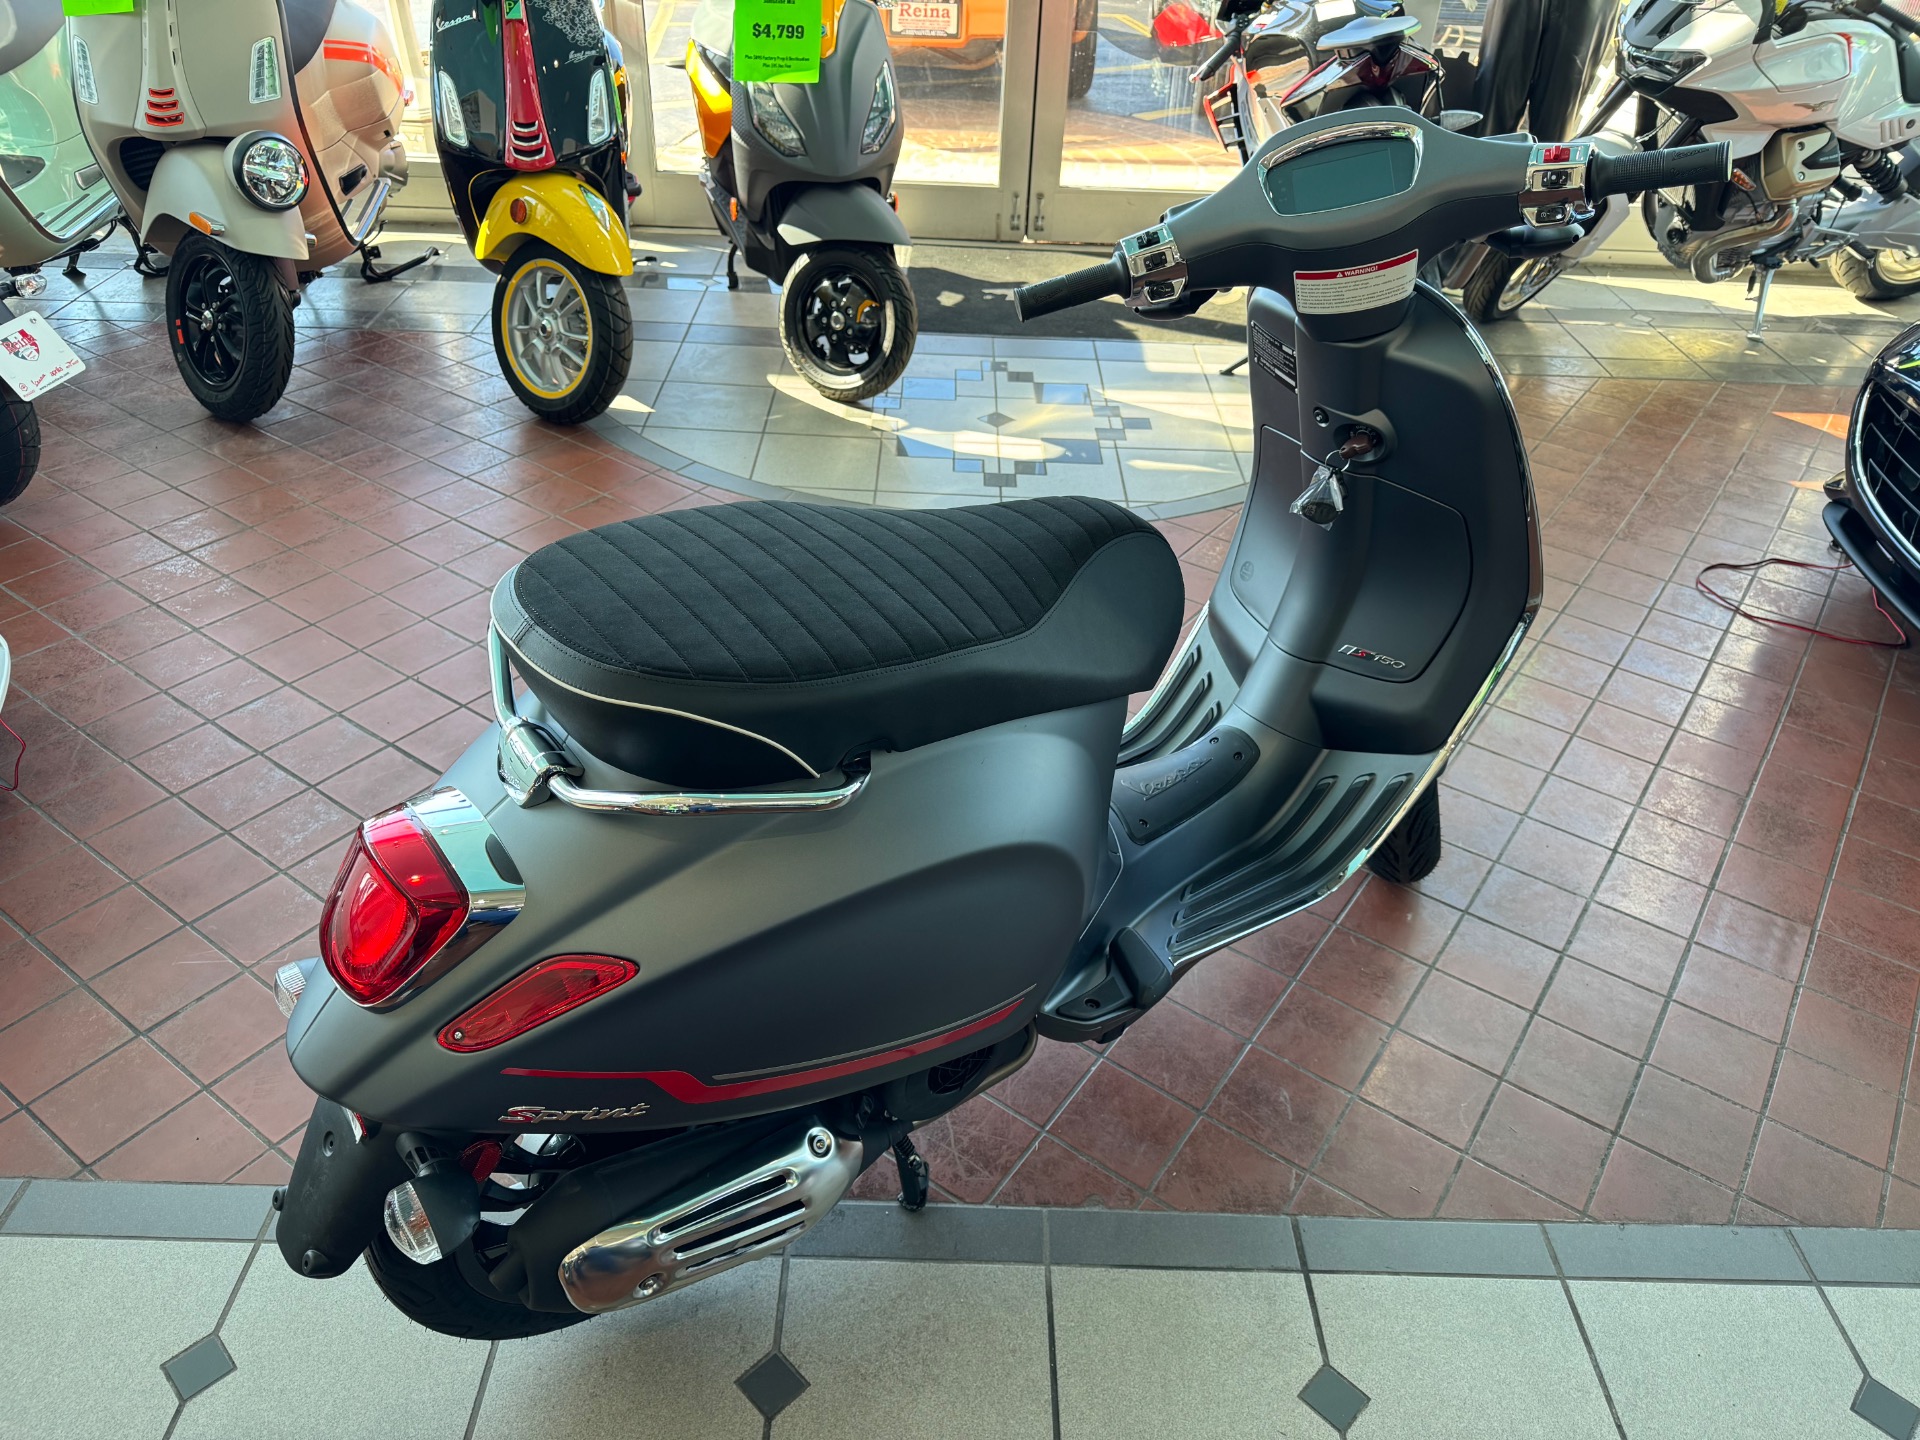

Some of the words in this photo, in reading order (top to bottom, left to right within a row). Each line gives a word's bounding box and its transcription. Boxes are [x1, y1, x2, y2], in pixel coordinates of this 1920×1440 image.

[899, 3, 951, 19] Reina
[436, 14, 475, 33] Vespa
[752, 22, 805, 40] $4,799
[1344, 265, 1379, 277] WARNING!
[1120, 757, 1214, 801] Vespa
[498, 1102, 651, 1124] Sprint
